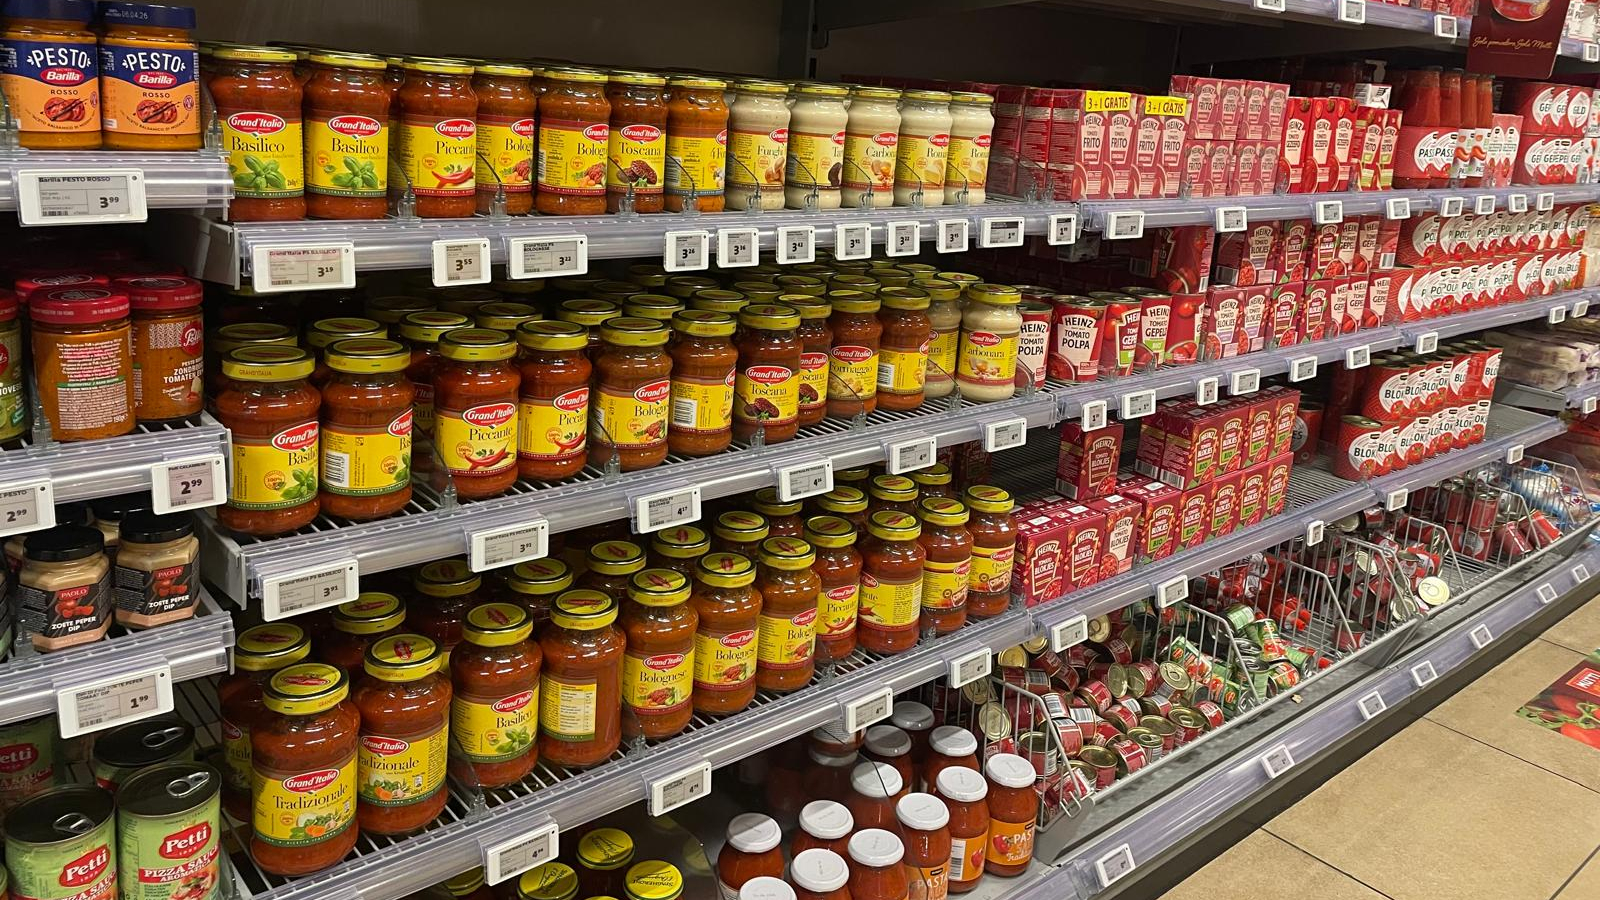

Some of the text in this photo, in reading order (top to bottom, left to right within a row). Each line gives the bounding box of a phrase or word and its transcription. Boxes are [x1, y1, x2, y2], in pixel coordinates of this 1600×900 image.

[32, 47, 88, 69] PESTO
[127, 52, 181, 73] PESTO
[46, 72, 81, 82] Barilla
[139, 74, 173, 85] Barilla
[50, 88, 79, 96] ROSSO
[142, 91, 171, 99] ROSSO
[1104, 97, 1128, 108] GRATIS
[1085, 115, 1102, 126] HEINZ
[1113, 116, 1129, 126] HEINZ
[1142, 120, 1158, 130] HEINZ
[1166, 121, 1183, 130] HEINZ
[231, 136, 285, 153] Basilico
[332, 138, 380, 154] Basilico
[1083, 138, 1100, 148] FRITO
[1111, 138, 1128, 148] FRITO
[1138, 141, 1156, 151] FRITO
[1164, 141, 1180, 151] FRITO
[618, 142, 660, 156] Toscana
[1256, 228, 1271, 236] HEINZ
[1250, 246, 1269, 254] BLOKJES
[1220, 302, 1237, 310] HEINZ
[1064, 316, 1094, 328] HEINZ
[1217, 320, 1235, 328] BLOKJES
[1020, 324, 1046, 334] HEINZ
[1064, 330, 1090, 339] TOMATO
[1062, 338, 1090, 350] POLPA
[1018, 346, 1044, 356] POLPA
[801, 372, 825, 382] oscana
[750, 384, 786, 396] Toscana
[468, 426, 512, 440] Piccante
[1094, 440, 1113, 449] HEINZ
[1092, 458, 1110, 466] BLOKJES
[4, 490, 28, 498] PESTO
[1116, 520, 1130, 530] HEINZ
[1078, 533, 1096, 542] HEINZ
[1114, 529, 1128, 538] TOMATO
[1110, 536, 1129, 548] BLOKJES
[1038, 544, 1058, 556] HEINZ
[1078, 544, 1091, 553] TOMATO
[1074, 550, 1093, 561] BLOKJES
[1038, 557, 1052, 566] TOMATO
[158, 568, 182, 578] PAOLO
[1034, 562, 1054, 574] BLOKJES
[61, 588, 86, 598] PAOLO
[148, 594, 190, 608] ZOETE PEPER
[164, 602, 175, 610] DIP
[52, 616, 96, 630] ZOETE PEPER
[68, 624, 80, 632] DIP
[640, 670, 687, 686] Bolognese
[496, 710, 533, 729] Basilico
[286, 771, 337, 788] Grand'Italia
[273, 784, 348, 810] Tradizionale
[166, 826, 208, 853] Petti
[66, 850, 107, 881] Petti
[144, 845, 218, 878] PIZZA SAUCE
[160, 858, 211, 882] AROMATICA
